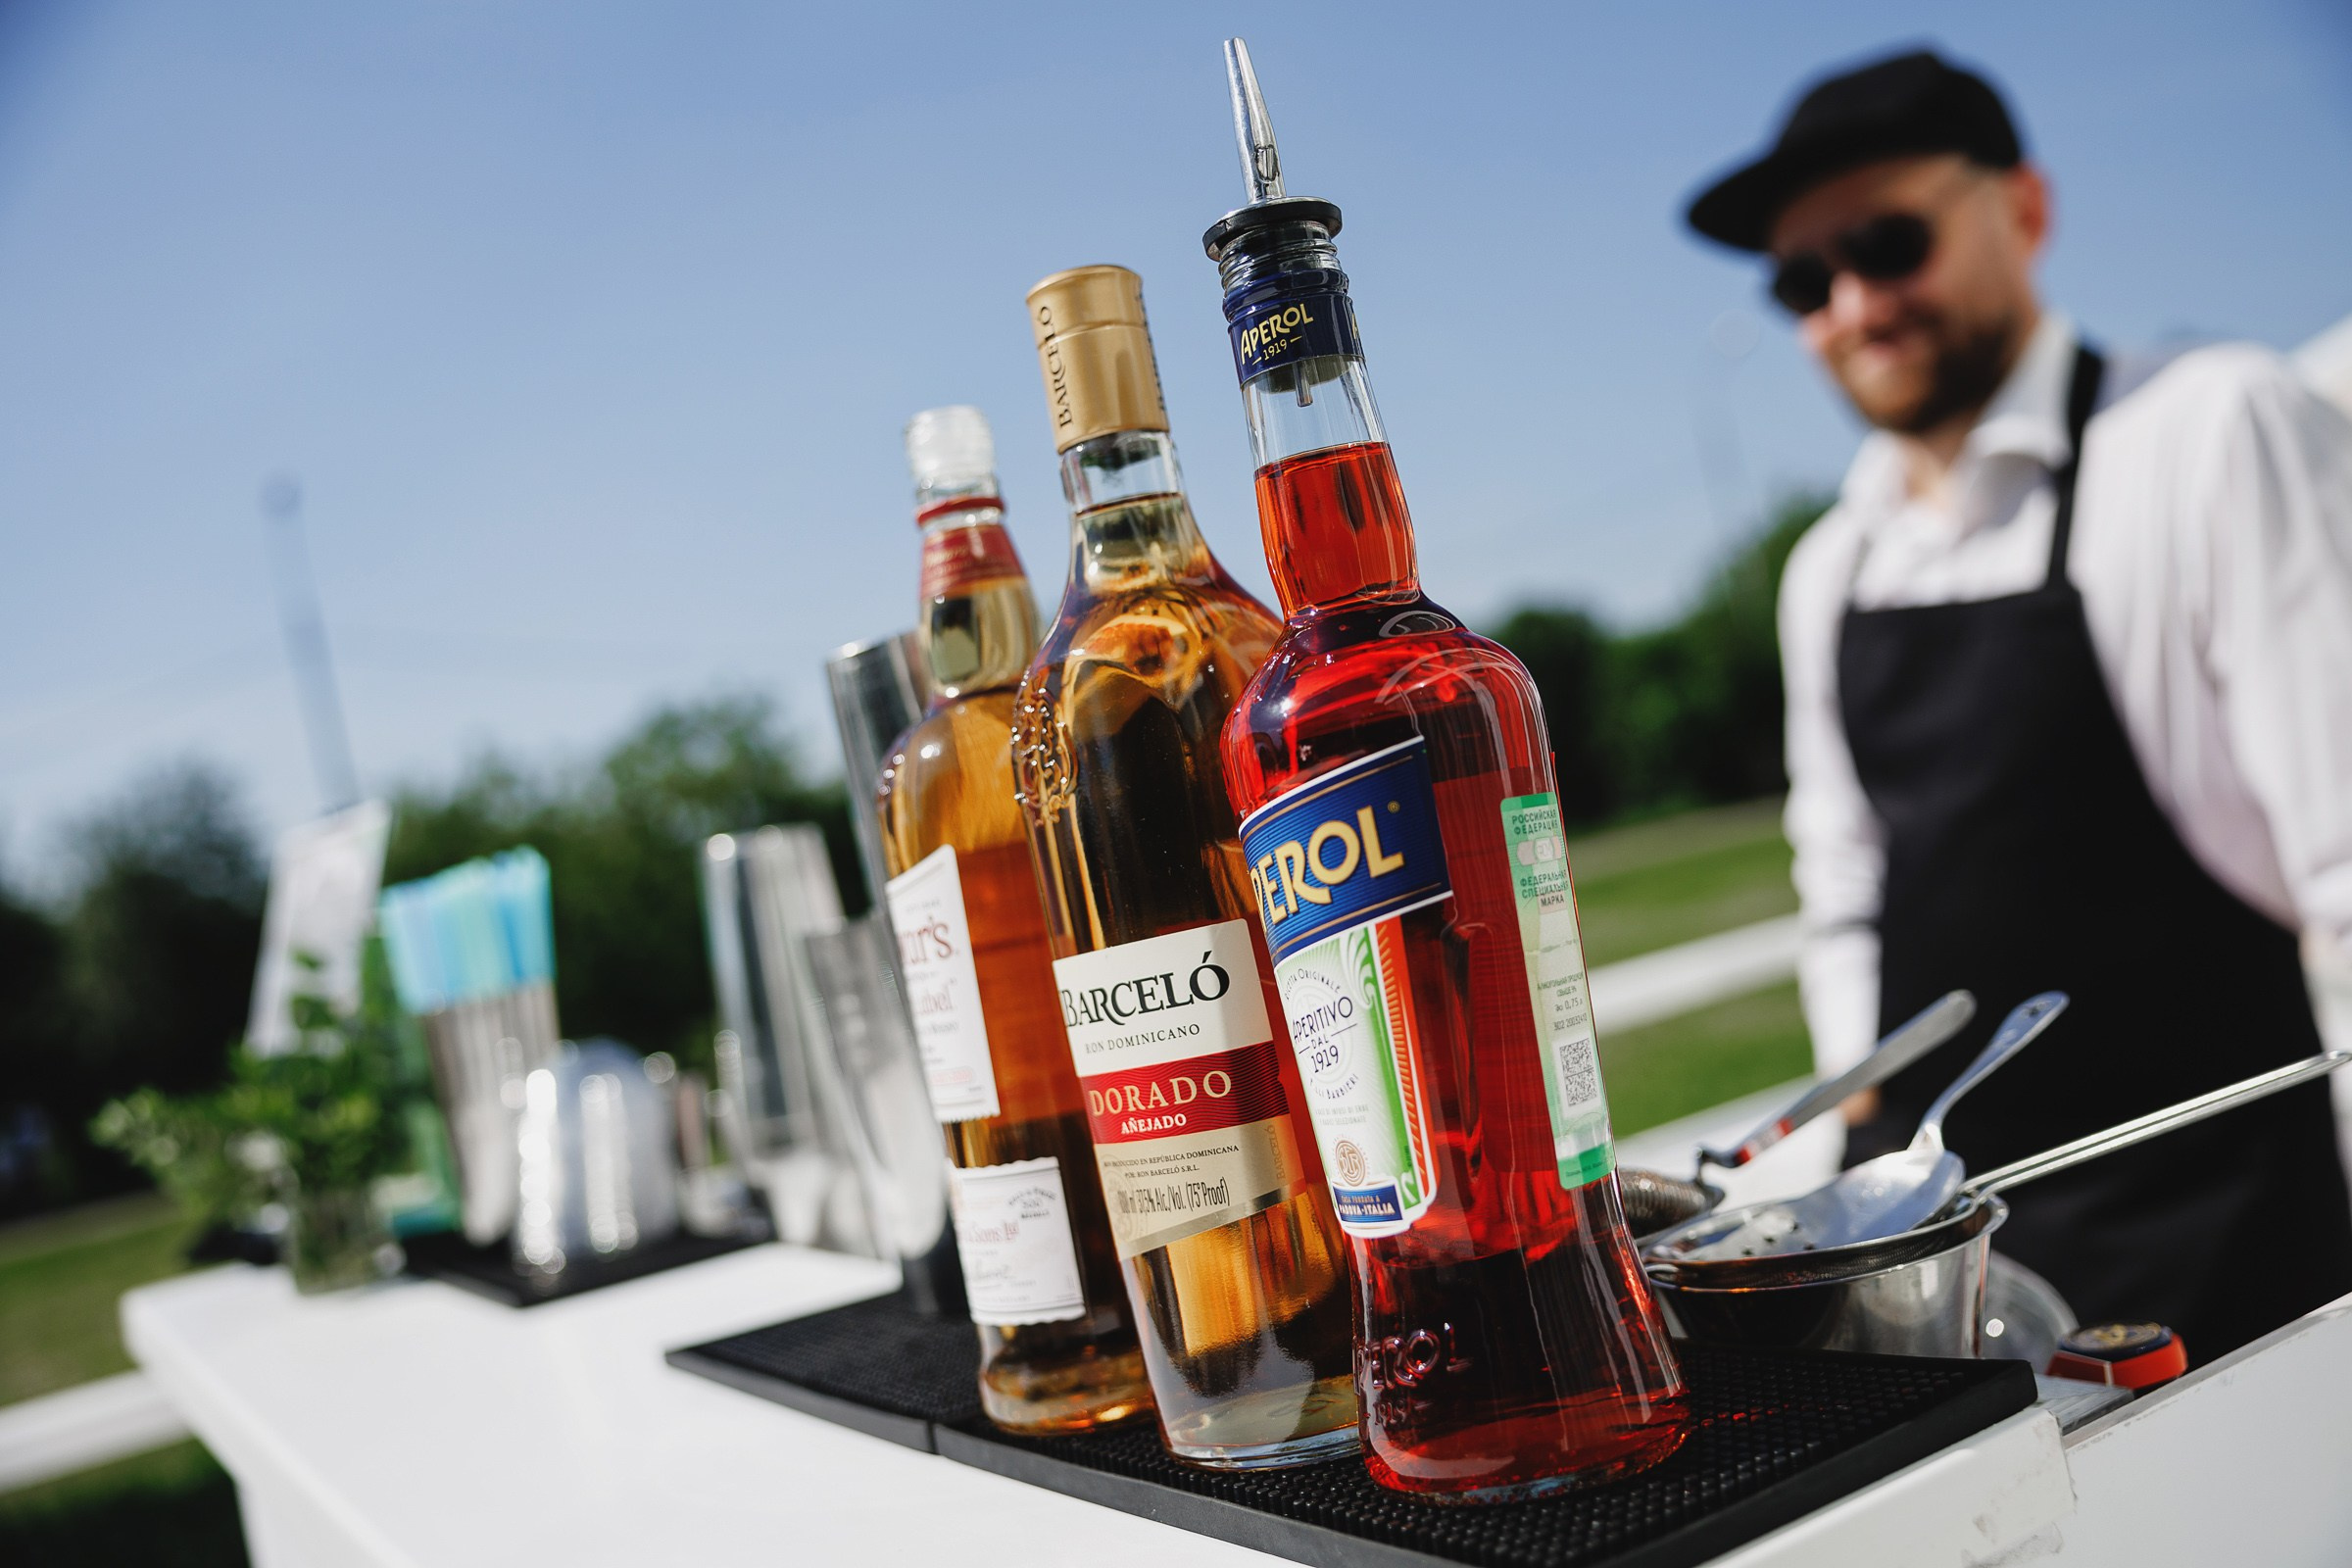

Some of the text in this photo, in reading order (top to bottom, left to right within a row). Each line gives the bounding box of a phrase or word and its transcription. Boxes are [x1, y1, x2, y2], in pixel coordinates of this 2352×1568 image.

[1241, 303, 1314, 366] APEROL
[1263, 338, 1289, 362] 1919
[1512, 808, 1557, 825] РОССИЙСКАЯ
[1513, 819, 1558, 835] ФЕДЕРАЦИЯ
[1247, 805, 1405, 935] PEROL
[1520, 869, 1567, 887] ФЕДЕРАЛЬНАЯ
[1521, 880, 1569, 899] СПЕЦИАЛЬНАЯ
[1541, 894, 1565, 907] МАРКА
[1061, 951, 1230, 1026] BARCELÓ
[1293, 996, 1353, 1045] APERITIVO
[1108, 1023, 1200, 1052] DOMINICANO
[1311, 1035, 1330, 1050] DAL
[1310, 1045, 1340, 1074] 1919
[1089, 1070, 1232, 1116] DORADO
[1121, 1113, 1187, 1135] AÑEJADO
[1149, 1154, 1186, 1164] REPÚBLICA
[1186, 1145, 1240, 1159] DOMINICANA
[1151, 1165, 1180, 1177] BARCELÓ
[1181, 1164, 1200, 1173] S.R.L.
